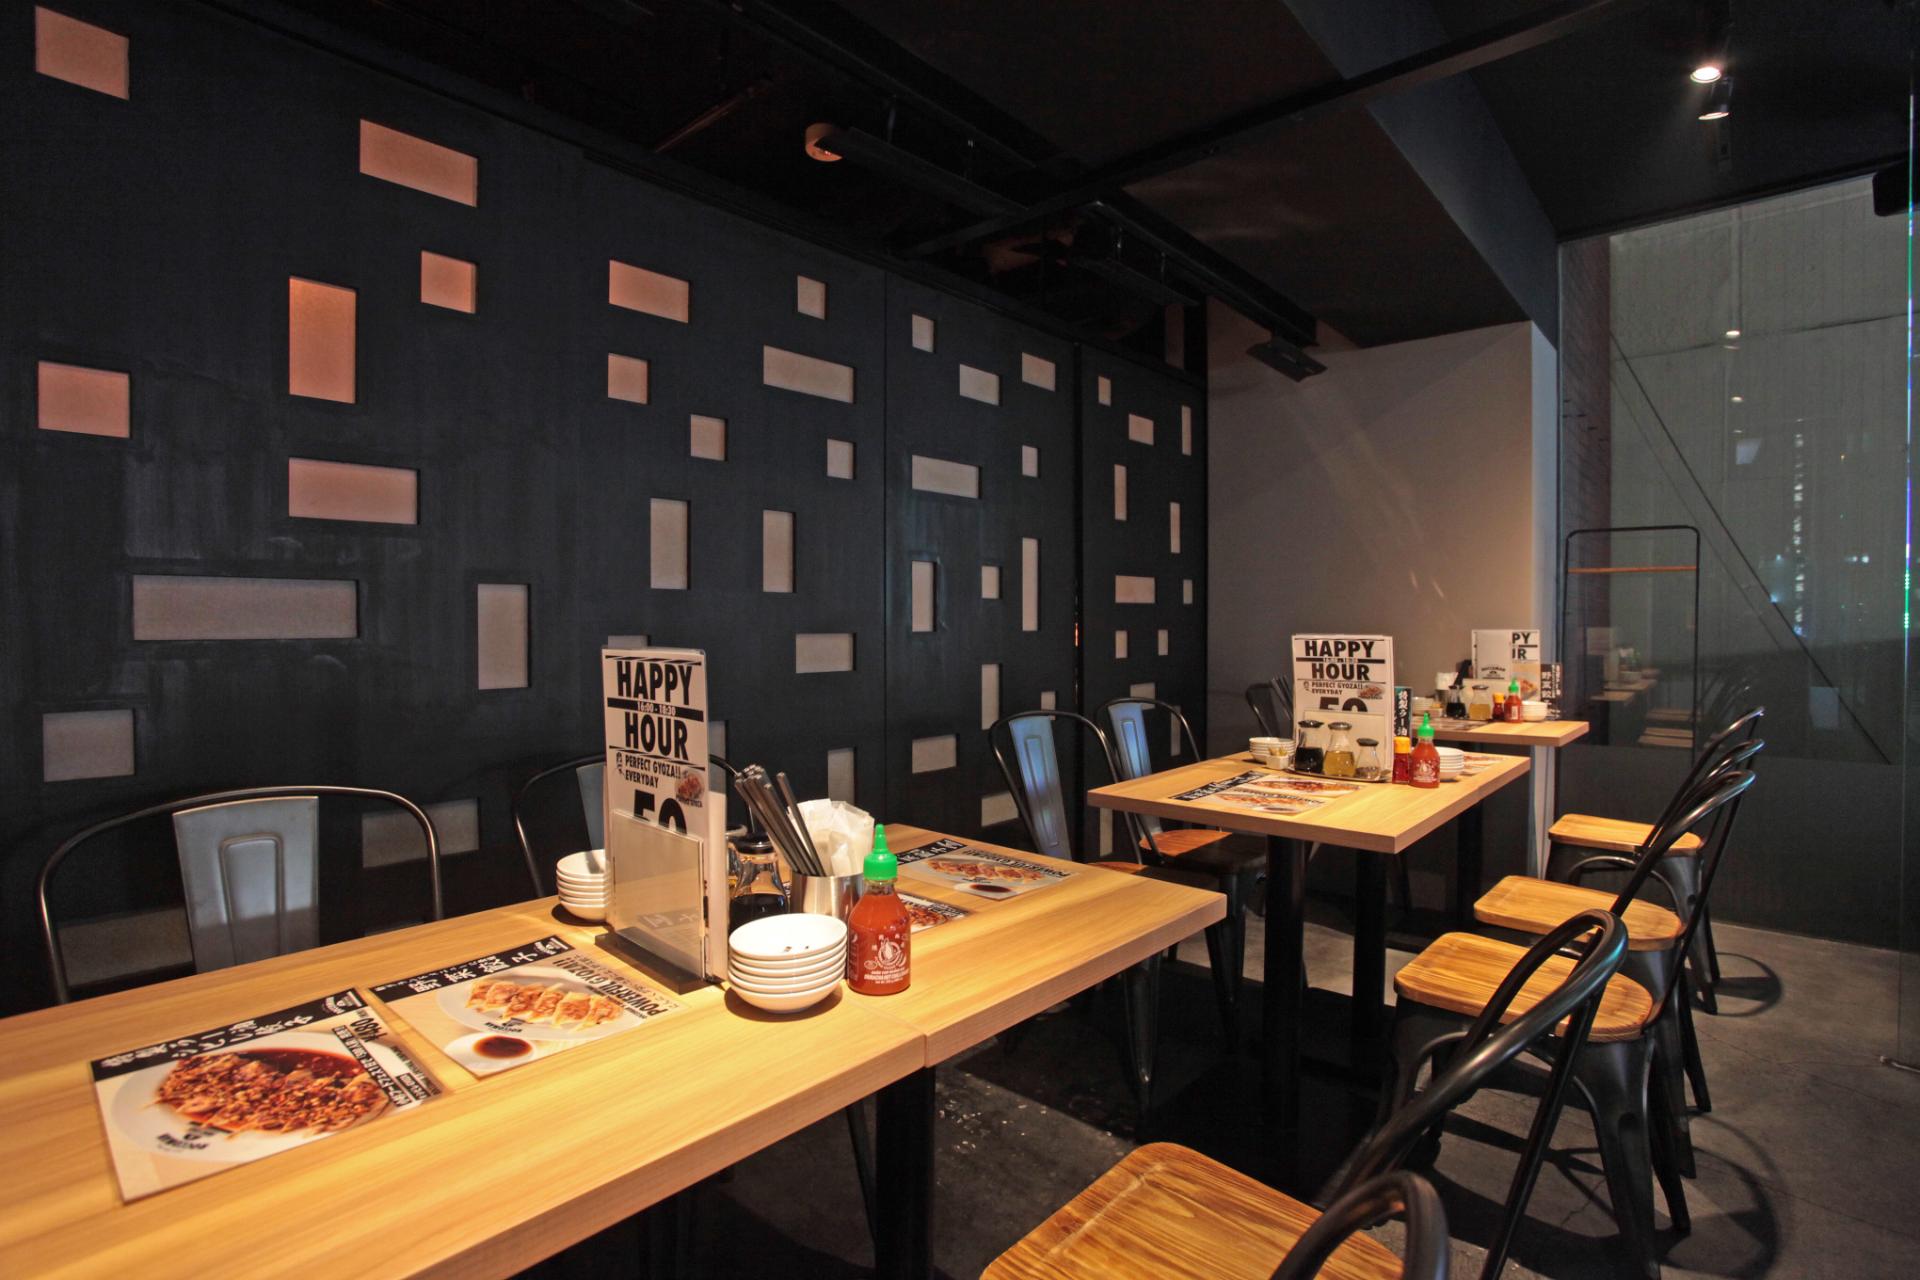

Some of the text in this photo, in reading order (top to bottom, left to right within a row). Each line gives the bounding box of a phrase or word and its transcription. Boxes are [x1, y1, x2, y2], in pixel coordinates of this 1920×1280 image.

[1304, 640, 1375, 658] HAPPY
[616, 660, 693, 706] HAPPY
[1311, 663, 1370, 681] HOUR
[624, 711, 689, 761] HOUR
[625, 754, 682, 780] PERFECT GYOZA!!
[625, 769, 659, 788] EVERYDAY
[552, 957, 608, 985] GYOZA!!
[600, 981, 669, 1016] POWERFUL
